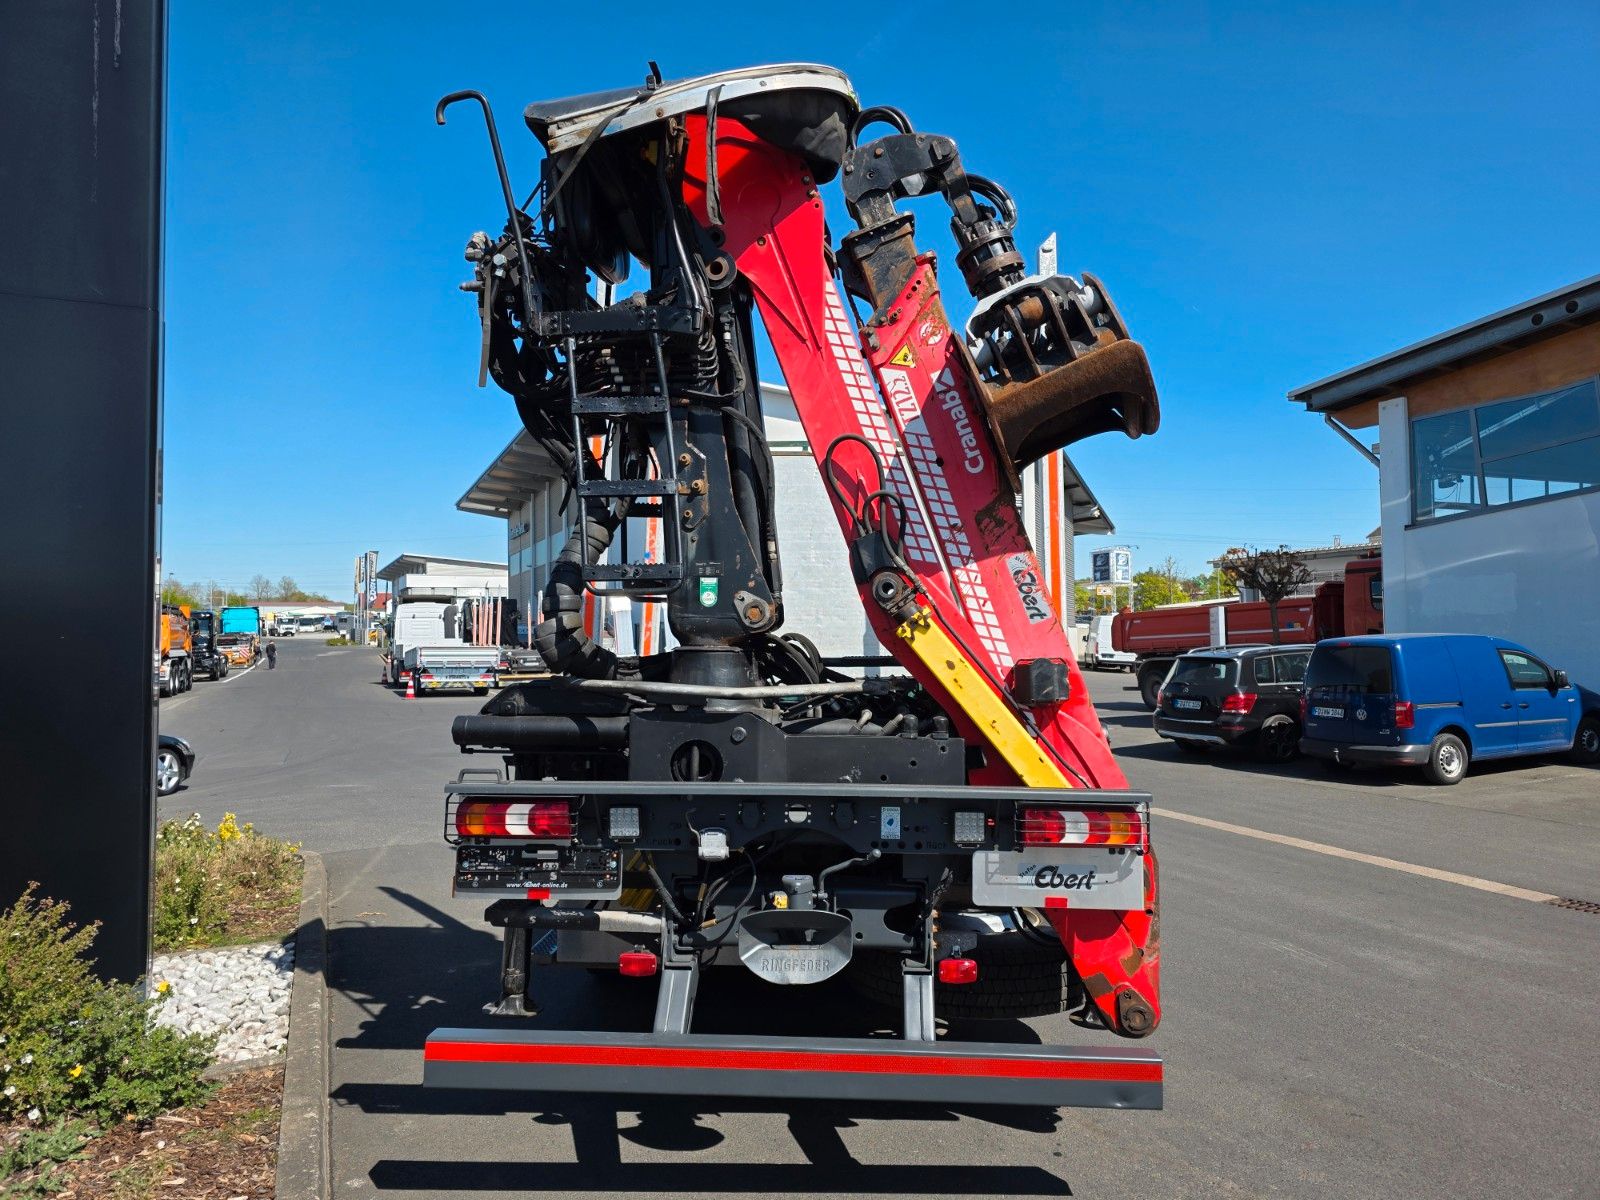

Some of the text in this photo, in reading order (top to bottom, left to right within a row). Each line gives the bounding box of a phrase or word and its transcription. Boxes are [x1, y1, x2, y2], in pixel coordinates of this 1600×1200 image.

[942, 390, 985, 474] Cranab
[1034, 865, 1096, 890] Ebert
[761, 958, 831, 972] RINGFEDER
